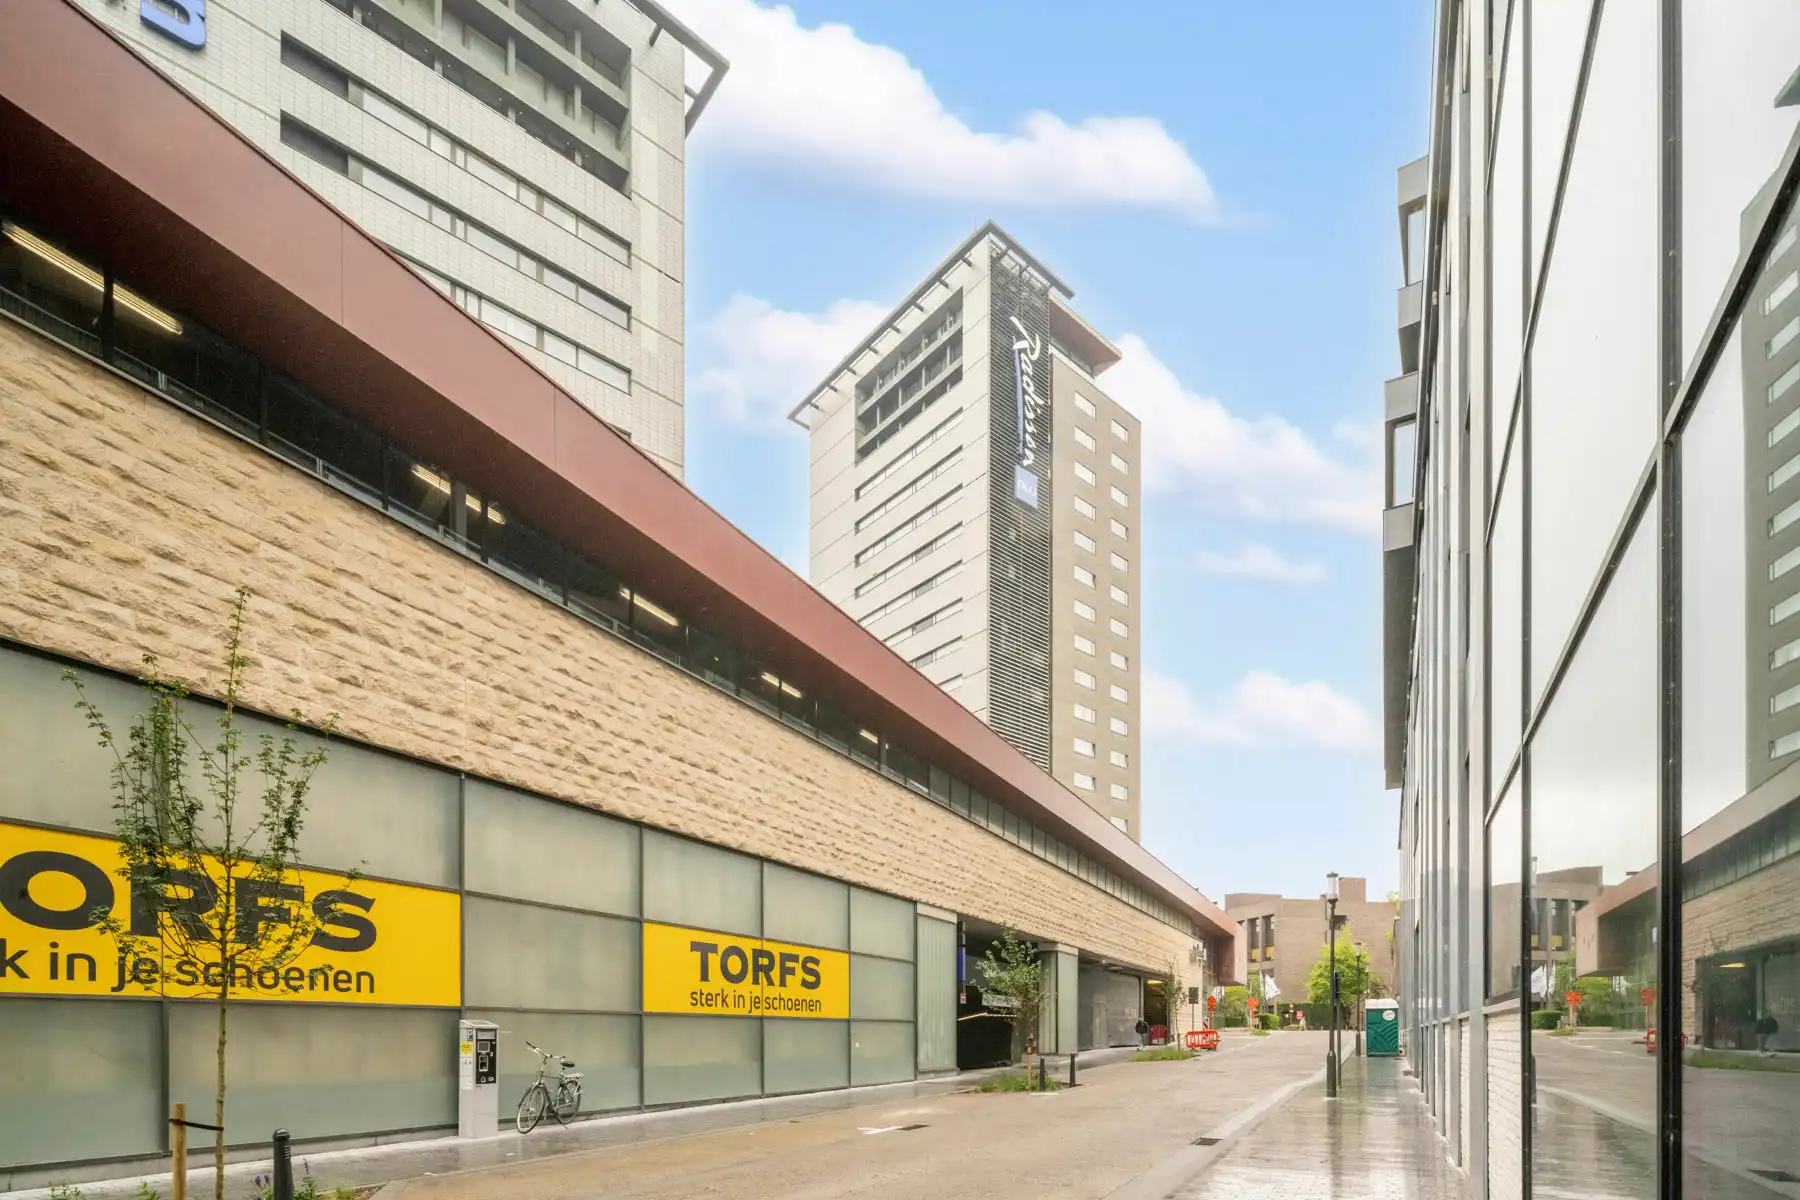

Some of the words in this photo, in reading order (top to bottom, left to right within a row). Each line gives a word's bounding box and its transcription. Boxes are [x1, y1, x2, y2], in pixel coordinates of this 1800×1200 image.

[1009, 316, 1044, 467] Radisson
[49, 941, 97, 981] in
[111, 946, 160, 992] je
[175, 955, 375, 994] schoenen
[690, 941, 822, 990] TORFS
[690, 988, 729, 1008] sterk
[733, 989, 746, 1008] in
[748, 991, 761, 1013] je
[764, 993, 822, 1012] schoenen
